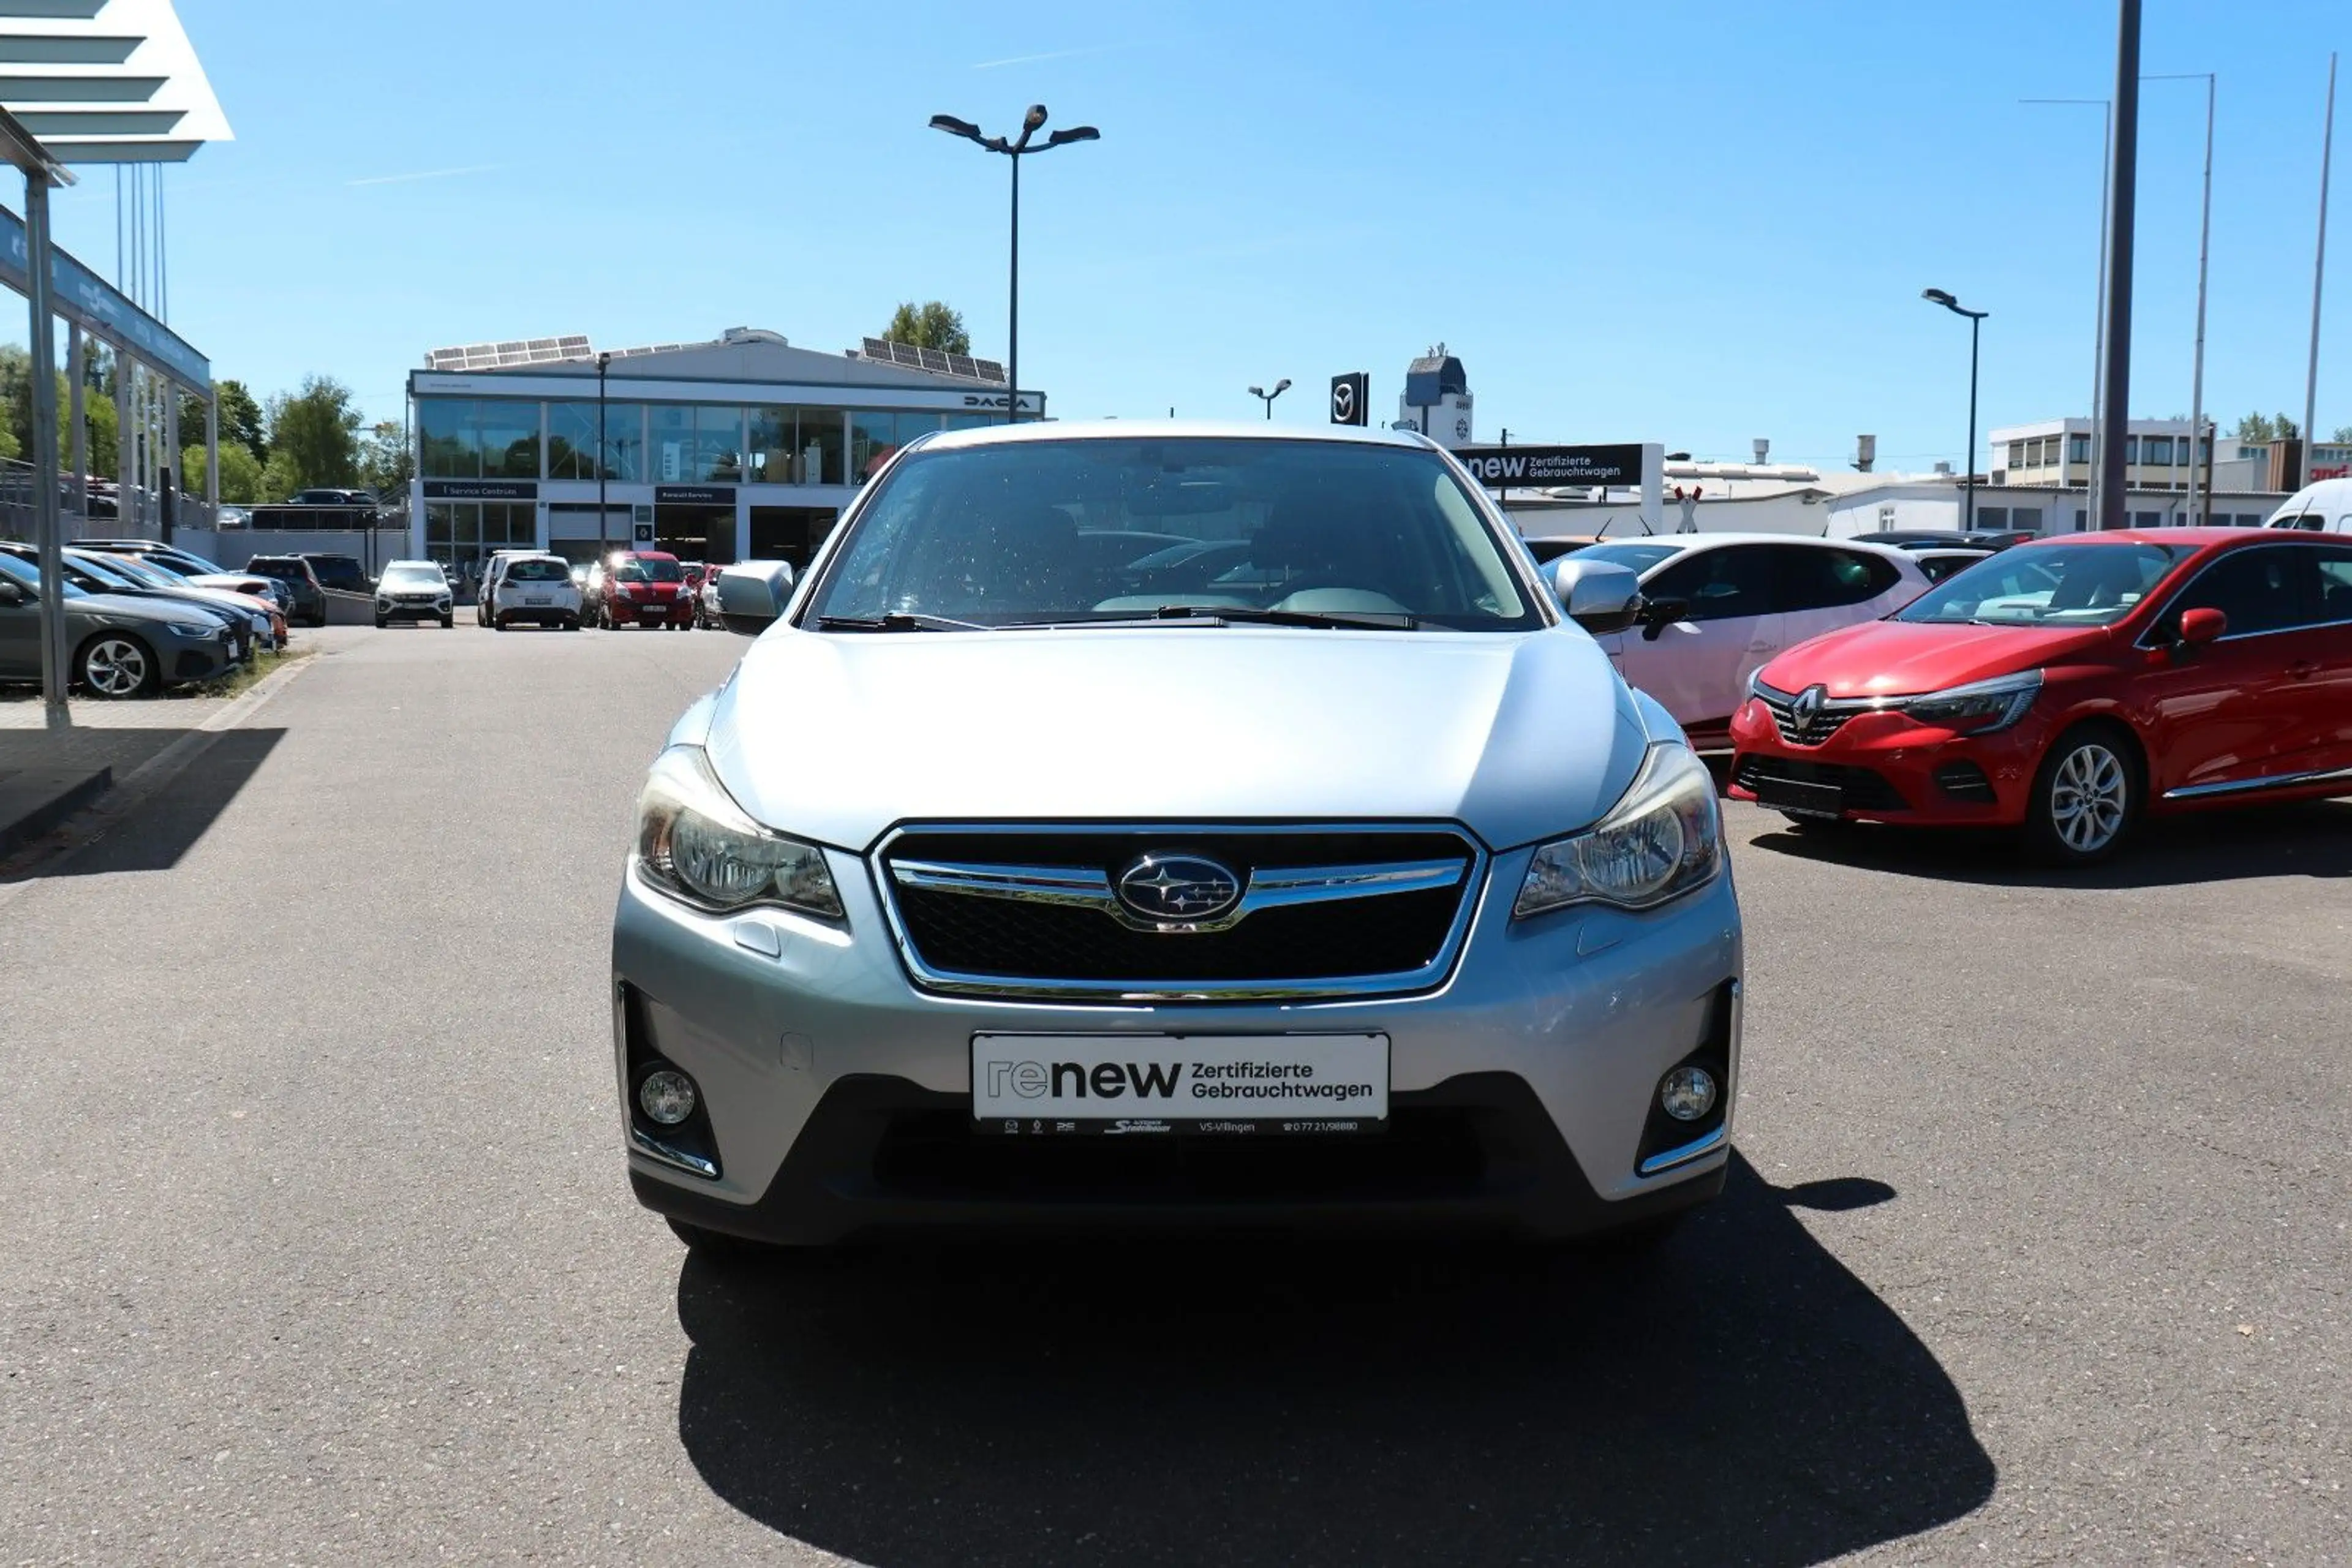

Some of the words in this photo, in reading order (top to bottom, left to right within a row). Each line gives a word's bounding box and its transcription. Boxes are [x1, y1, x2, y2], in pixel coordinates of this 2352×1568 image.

[964, 396, 1030, 408] DACA
[1530, 455, 1591, 467] Zertifizierte
[1529, 466, 1621, 478] Gebrauchtwagen
[1191, 1061, 1314, 1079] Zertifizierte
[987, 1060, 1182, 1099] renew
[1191, 1081, 1373, 1102] Gebrauchtwagen
